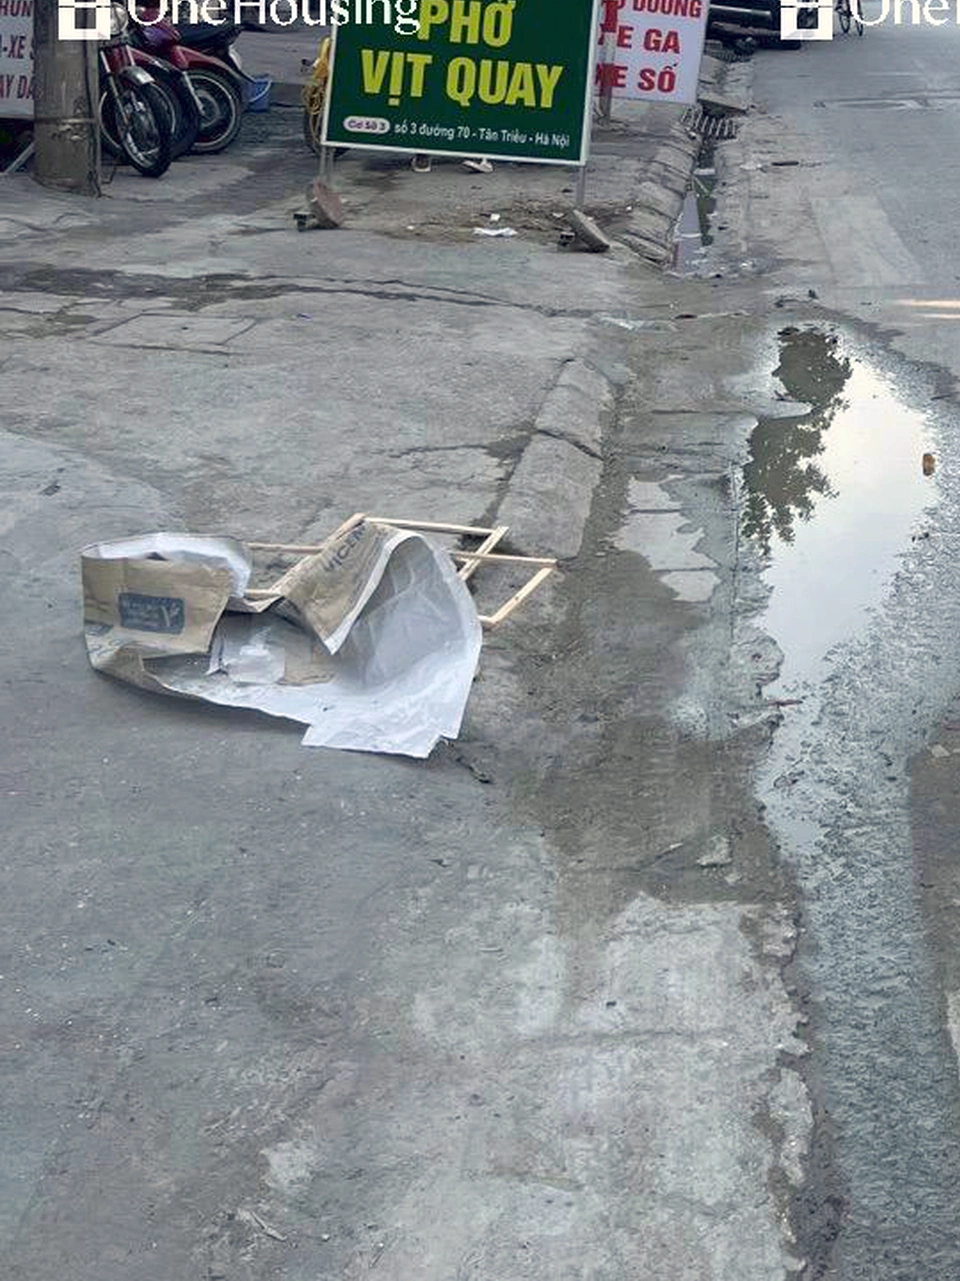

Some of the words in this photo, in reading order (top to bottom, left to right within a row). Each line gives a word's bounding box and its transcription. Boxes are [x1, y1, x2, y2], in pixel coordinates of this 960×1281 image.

[644, 29, 680, 54] GA
[361, 49, 433, 106] VỊT
[446, 57, 564, 108] QUAY
[637, 62, 678, 93] SỐ
[410, 122, 417, 134] 3
[457, 126, 470, 139] 70
